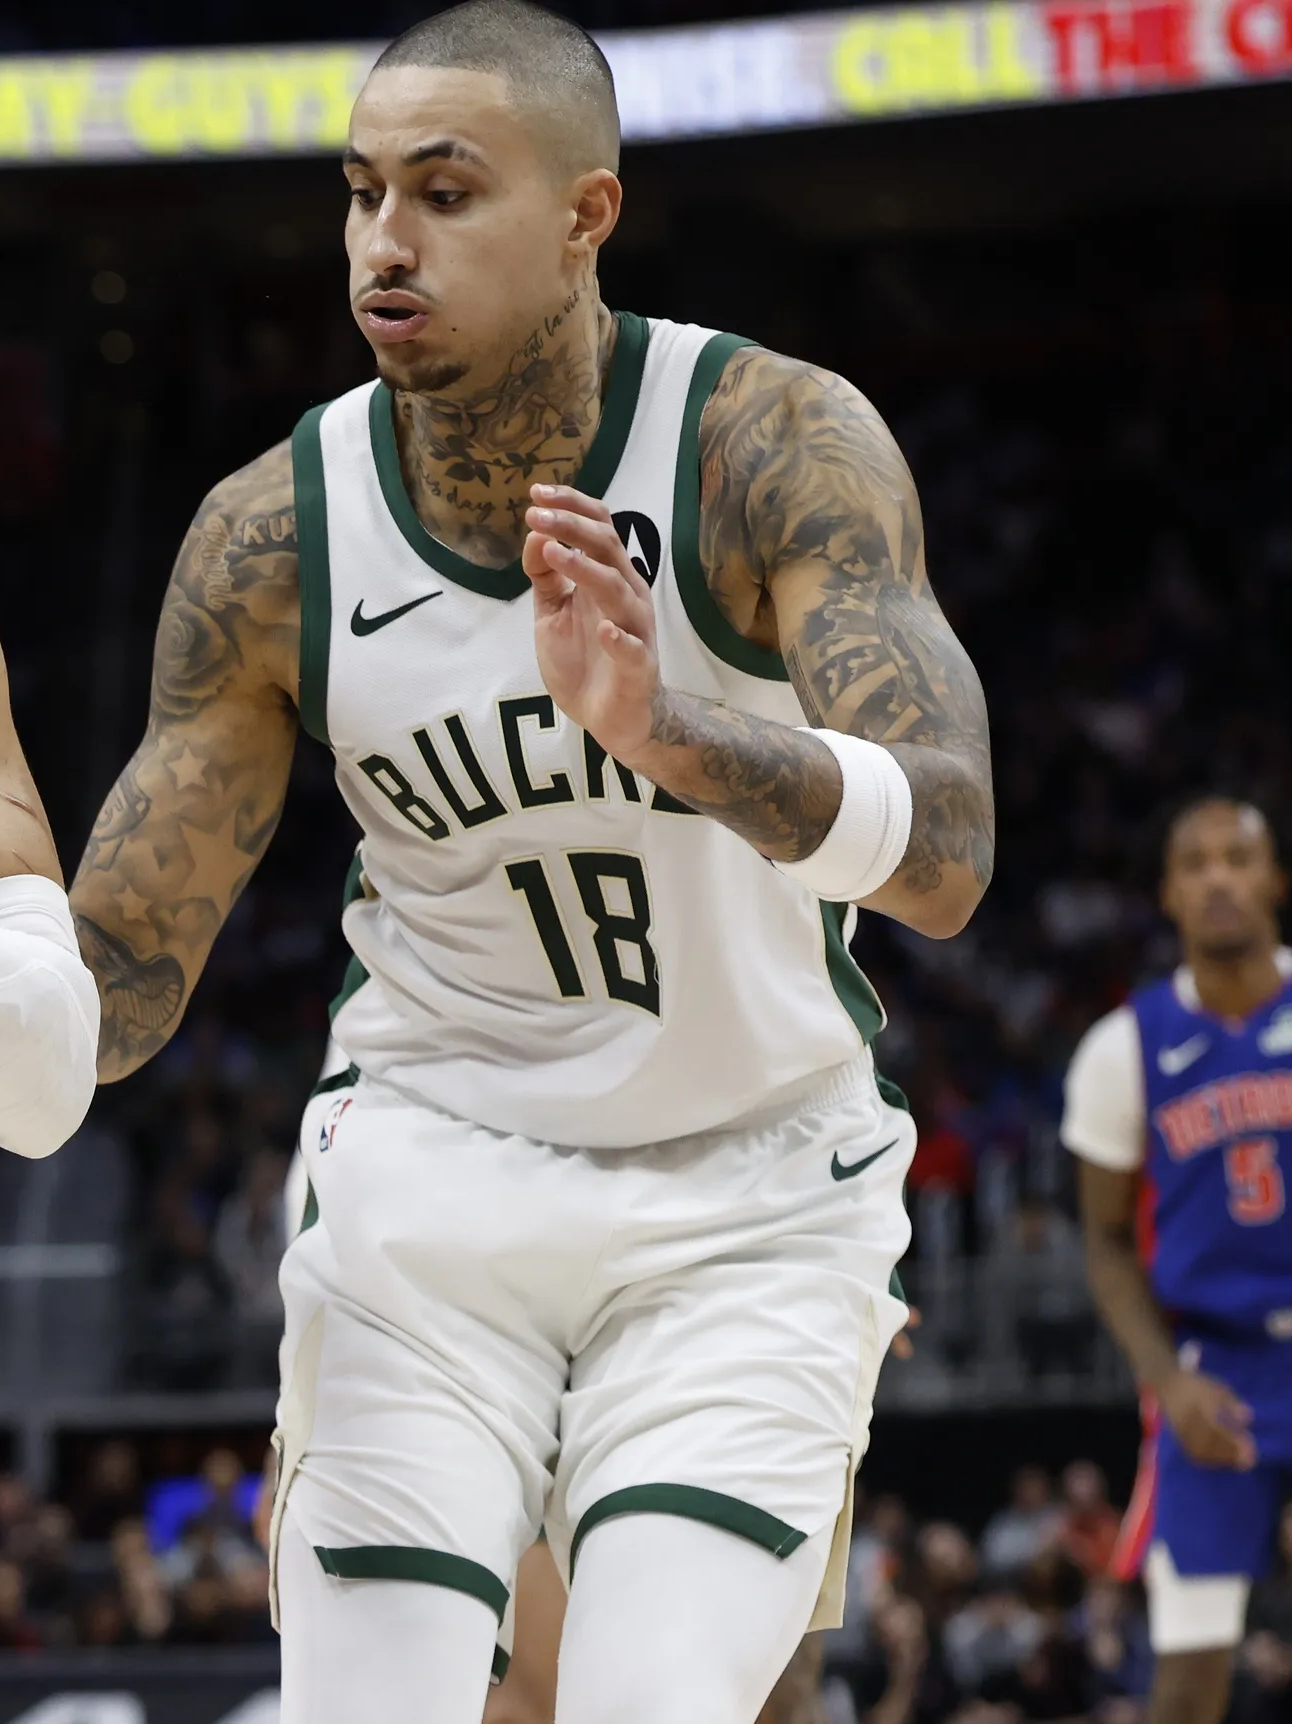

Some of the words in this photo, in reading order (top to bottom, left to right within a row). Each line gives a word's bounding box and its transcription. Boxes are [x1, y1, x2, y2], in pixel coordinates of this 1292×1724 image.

[354, 690, 708, 843] BUCK
[499, 847, 664, 1026] 18
[1224, 1134, 1285, 1227] 5
